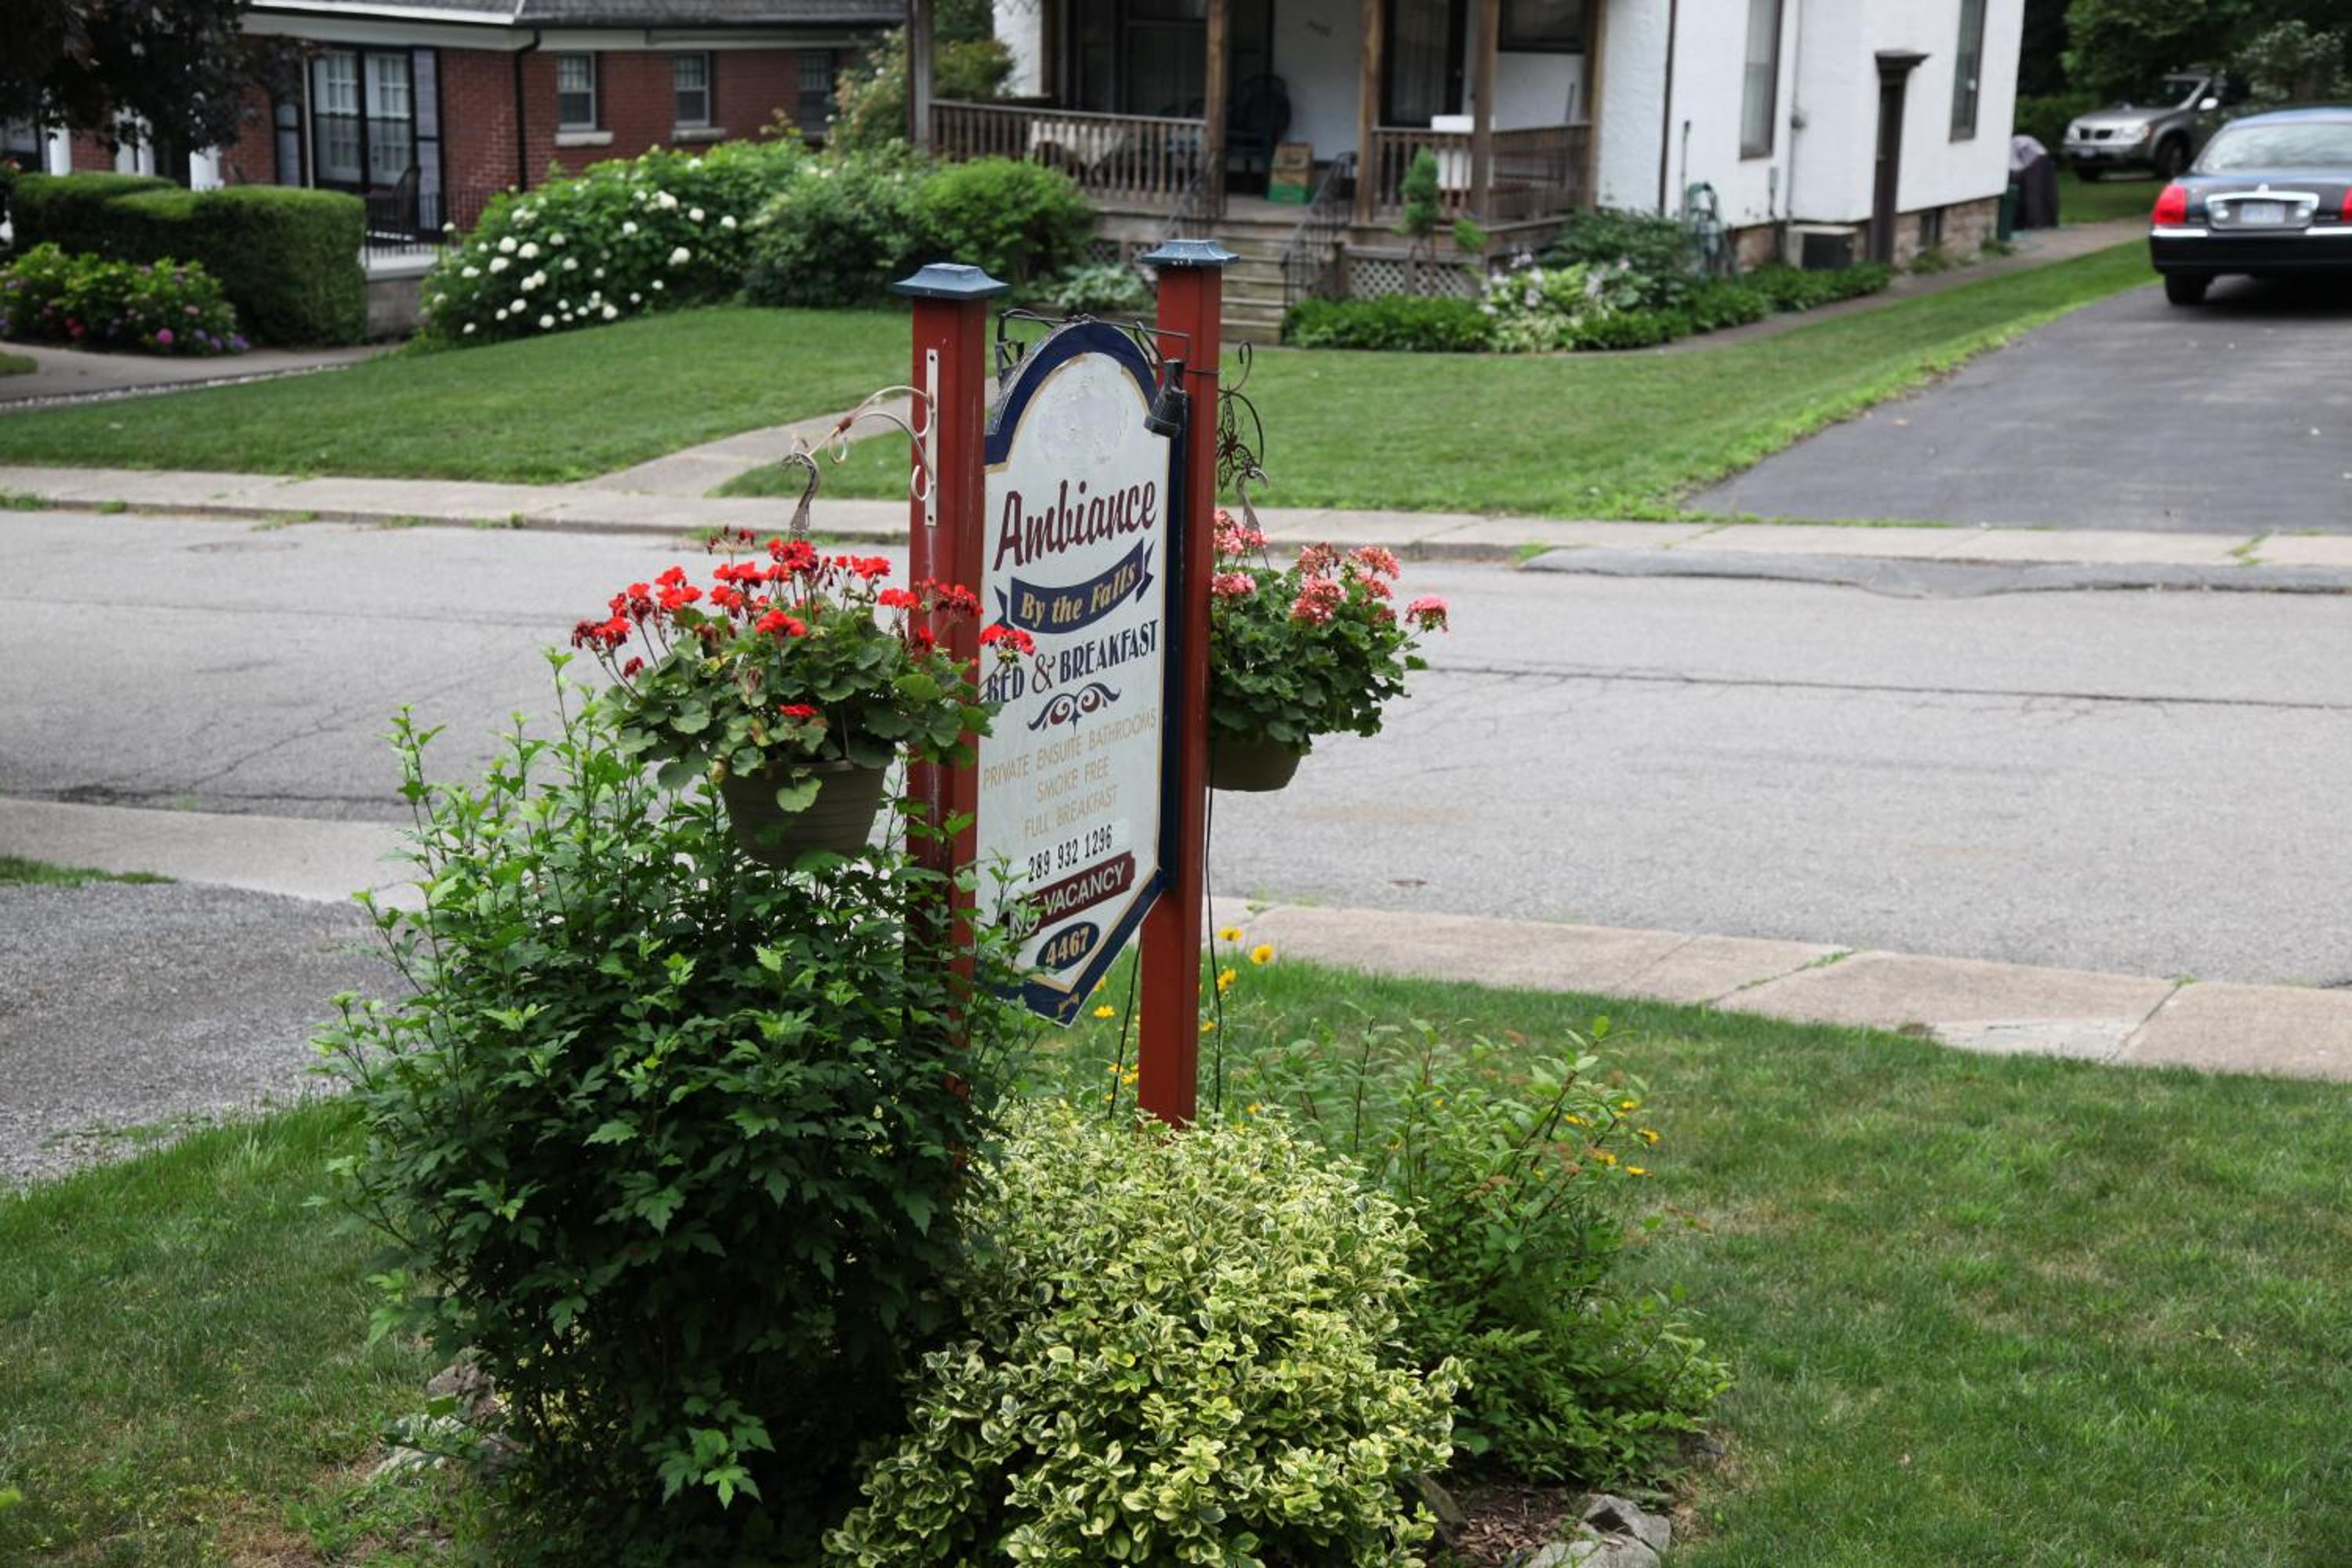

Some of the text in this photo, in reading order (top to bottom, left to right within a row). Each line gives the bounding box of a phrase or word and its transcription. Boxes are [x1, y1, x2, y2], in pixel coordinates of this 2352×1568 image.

[993, 480, 1156, 571] Ambiance
[1020, 562, 1137, 628] By the Falls
[987, 619, 1158, 702] BED & BREAKFAST
[983, 708, 1156, 790] PRIVATE ENSUITE BATHROOMS
[1037, 755, 1109, 803] SMOKE FREE
[1024, 786, 1117, 840] FULL BREAKFAST
[1028, 824, 1112, 884] 289 932 1296
[1044, 862, 1126, 916] VACANCY
[1045, 926, 1091, 967] 4467
